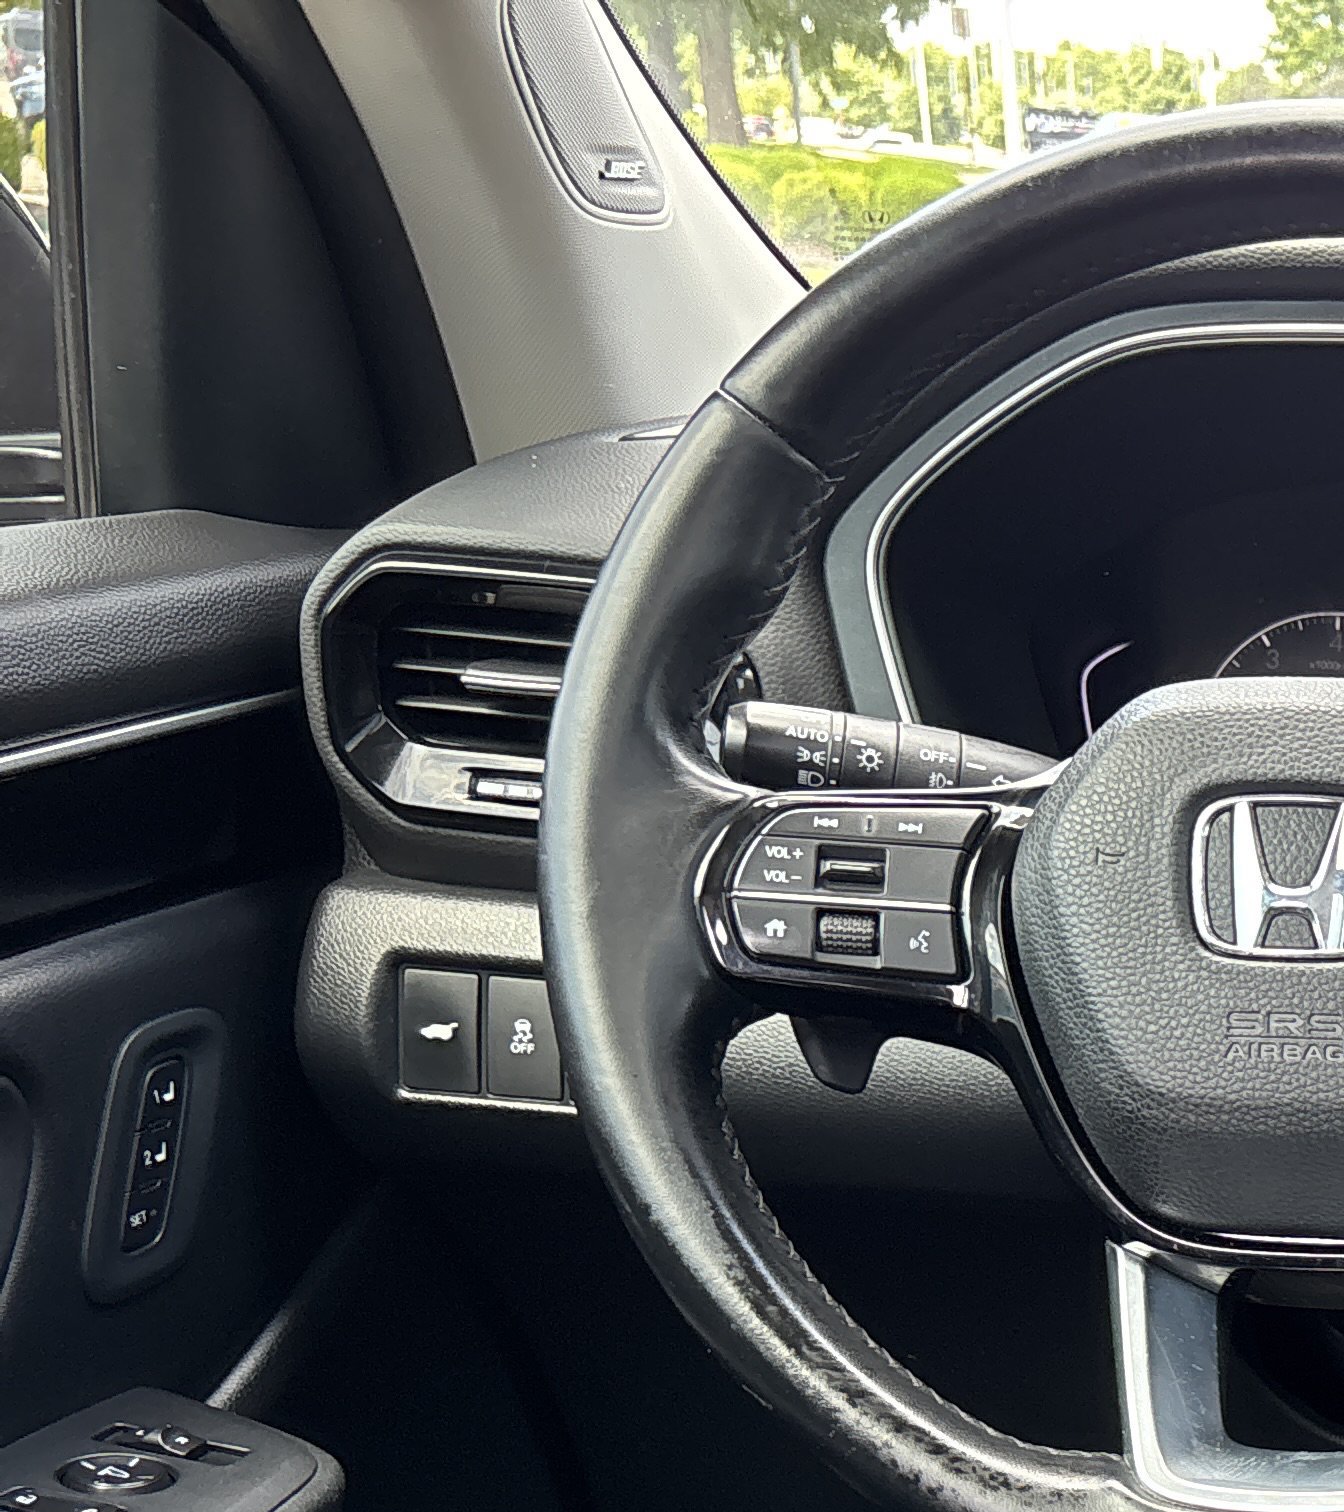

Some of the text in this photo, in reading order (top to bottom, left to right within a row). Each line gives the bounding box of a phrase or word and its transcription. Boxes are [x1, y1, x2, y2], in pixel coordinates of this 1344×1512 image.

[1266, 650, 1280, 670] 3
[785, 725, 829, 743] AUTO
[920, 749, 948, 763] OFF
[765, 845, 803, 861] VOL+
[1226, 1011, 1343, 1037] SRS
[510, 1041, 535, 1055] OFF
[1225, 1042, 1344, 1062] AIRBAG
[142, 1150, 152, 1167] 2
[129, 1209, 147, 1227] SET
